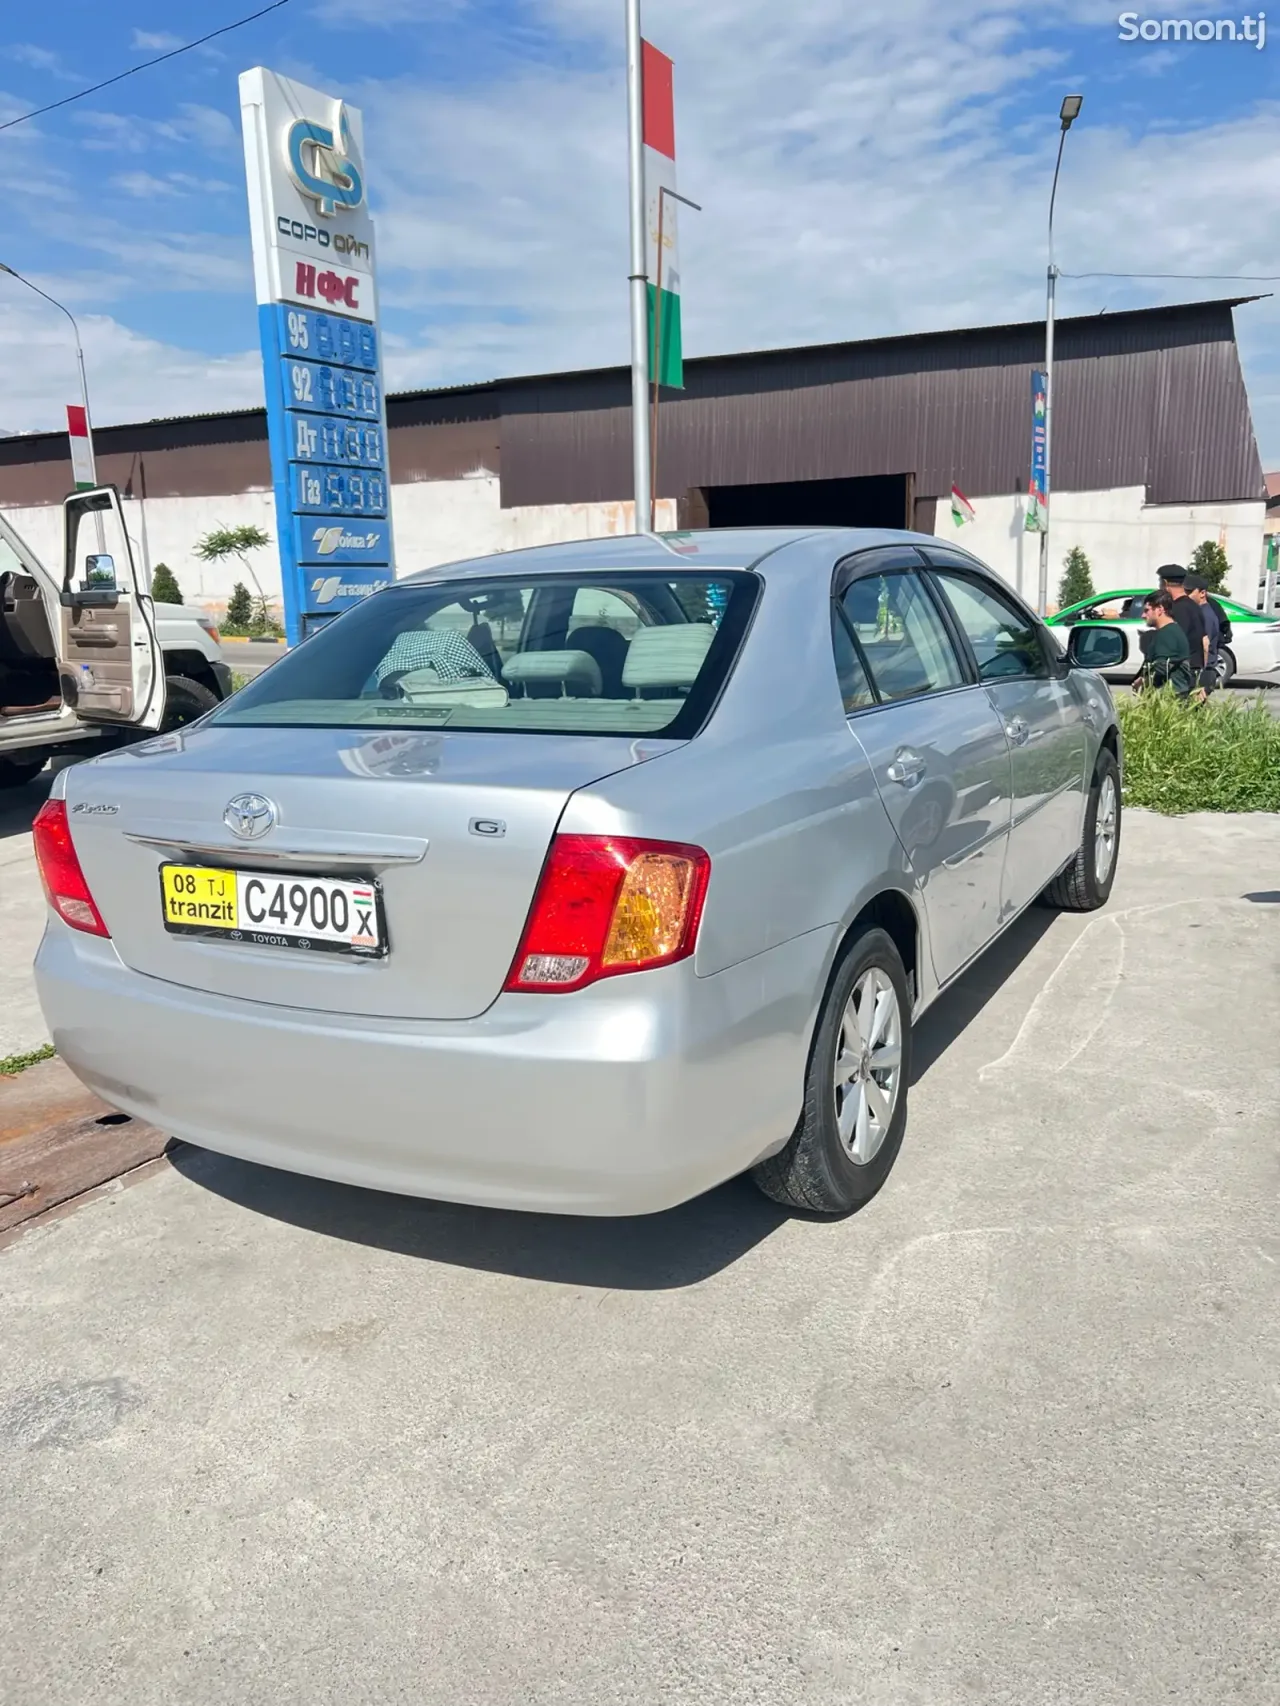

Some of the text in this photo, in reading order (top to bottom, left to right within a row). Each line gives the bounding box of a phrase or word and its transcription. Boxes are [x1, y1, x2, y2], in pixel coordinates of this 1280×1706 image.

[295, 261, 359, 309] НФС
[288, 311, 309, 350] 95
[292, 365, 313, 402] 92
[297, 420, 317, 458] Дт
[301, 470, 321, 505] Газ
[475, 820, 498, 834] G
[173, 873, 225, 896] 08 TJ
[170, 896, 234, 921] tranzit
[245, 879, 349, 932] C4900
[252, 932, 289, 947] TOYOTA
